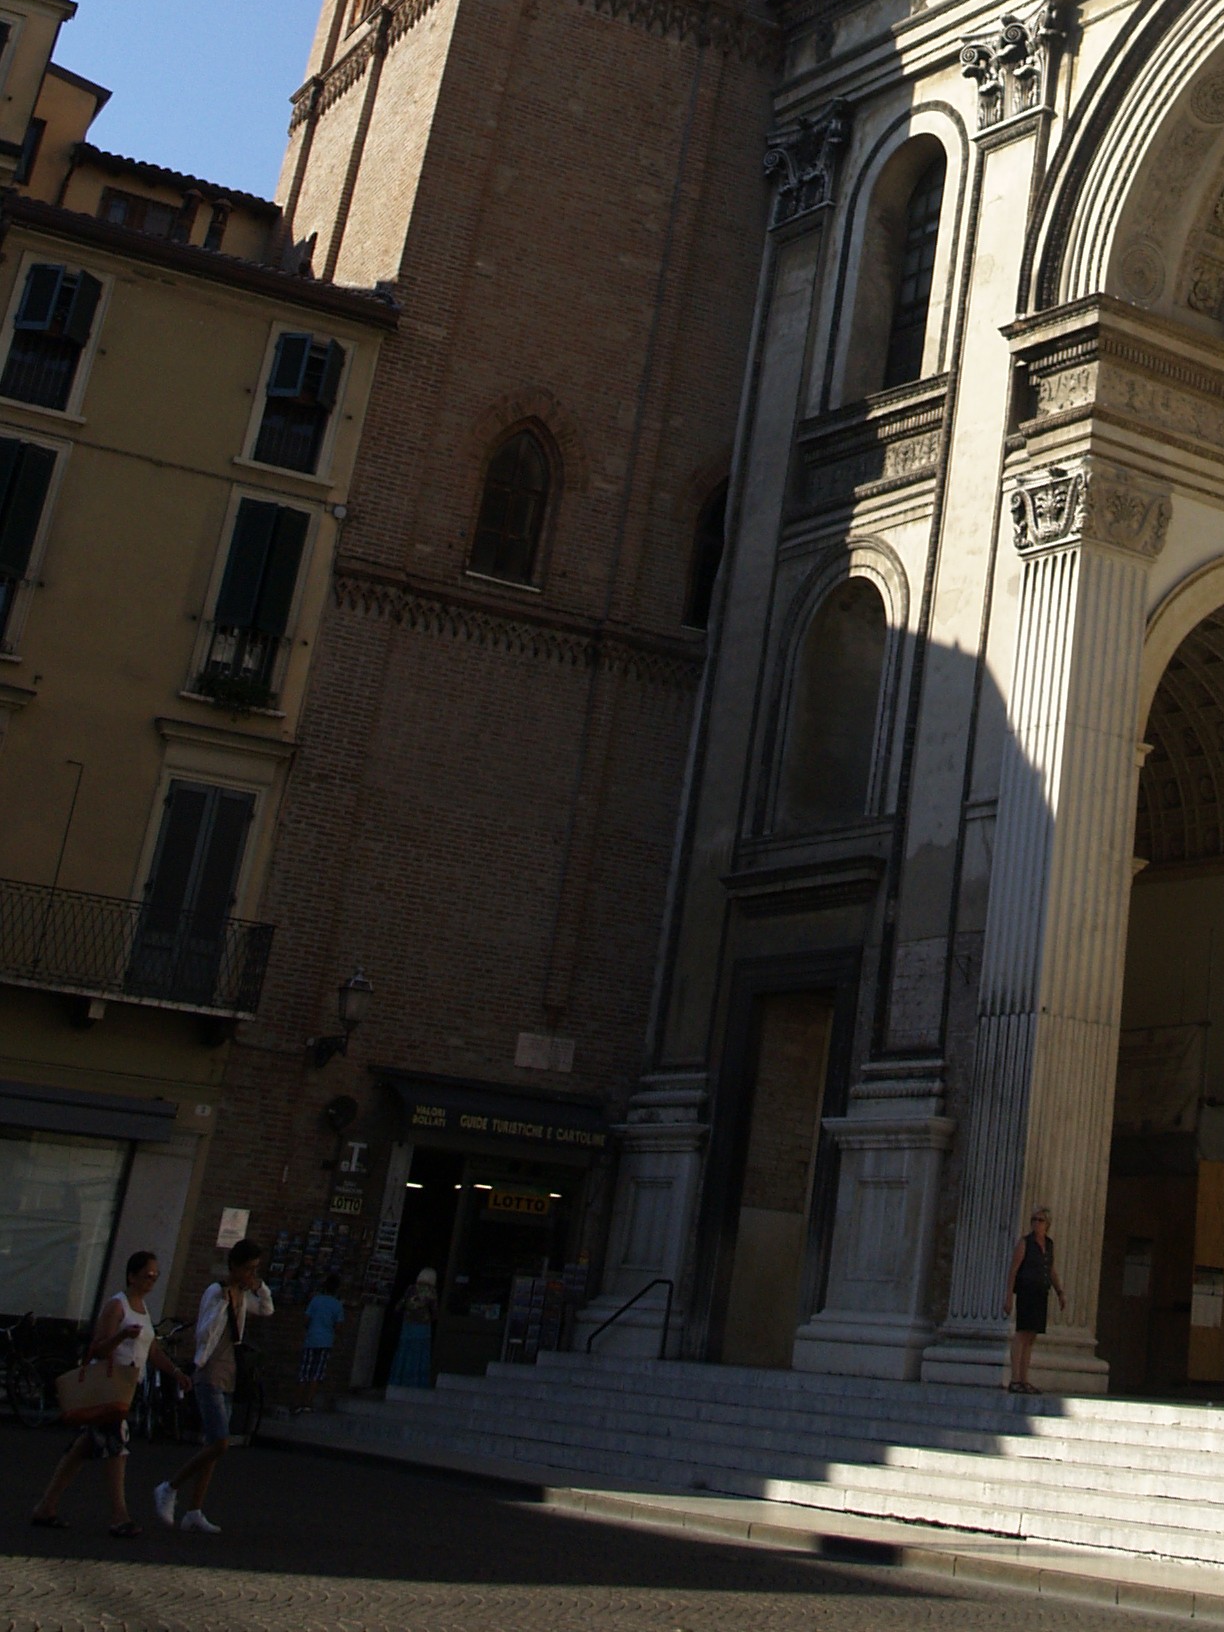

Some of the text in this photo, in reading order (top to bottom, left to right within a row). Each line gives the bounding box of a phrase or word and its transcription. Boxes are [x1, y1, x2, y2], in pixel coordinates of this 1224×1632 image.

[415, 1104, 446, 1117] VALORI
[412, 1114, 447, 1128] BOLLATI
[460, 1114, 489, 1130] GUIDE
[492, 1118, 544, 1138] TURISTICHE
[556, 1128, 607, 1147] CARTOLINE
[331, 1197, 361, 1211] LOTTO
[493, 1194, 545, 1211] LOTTO
